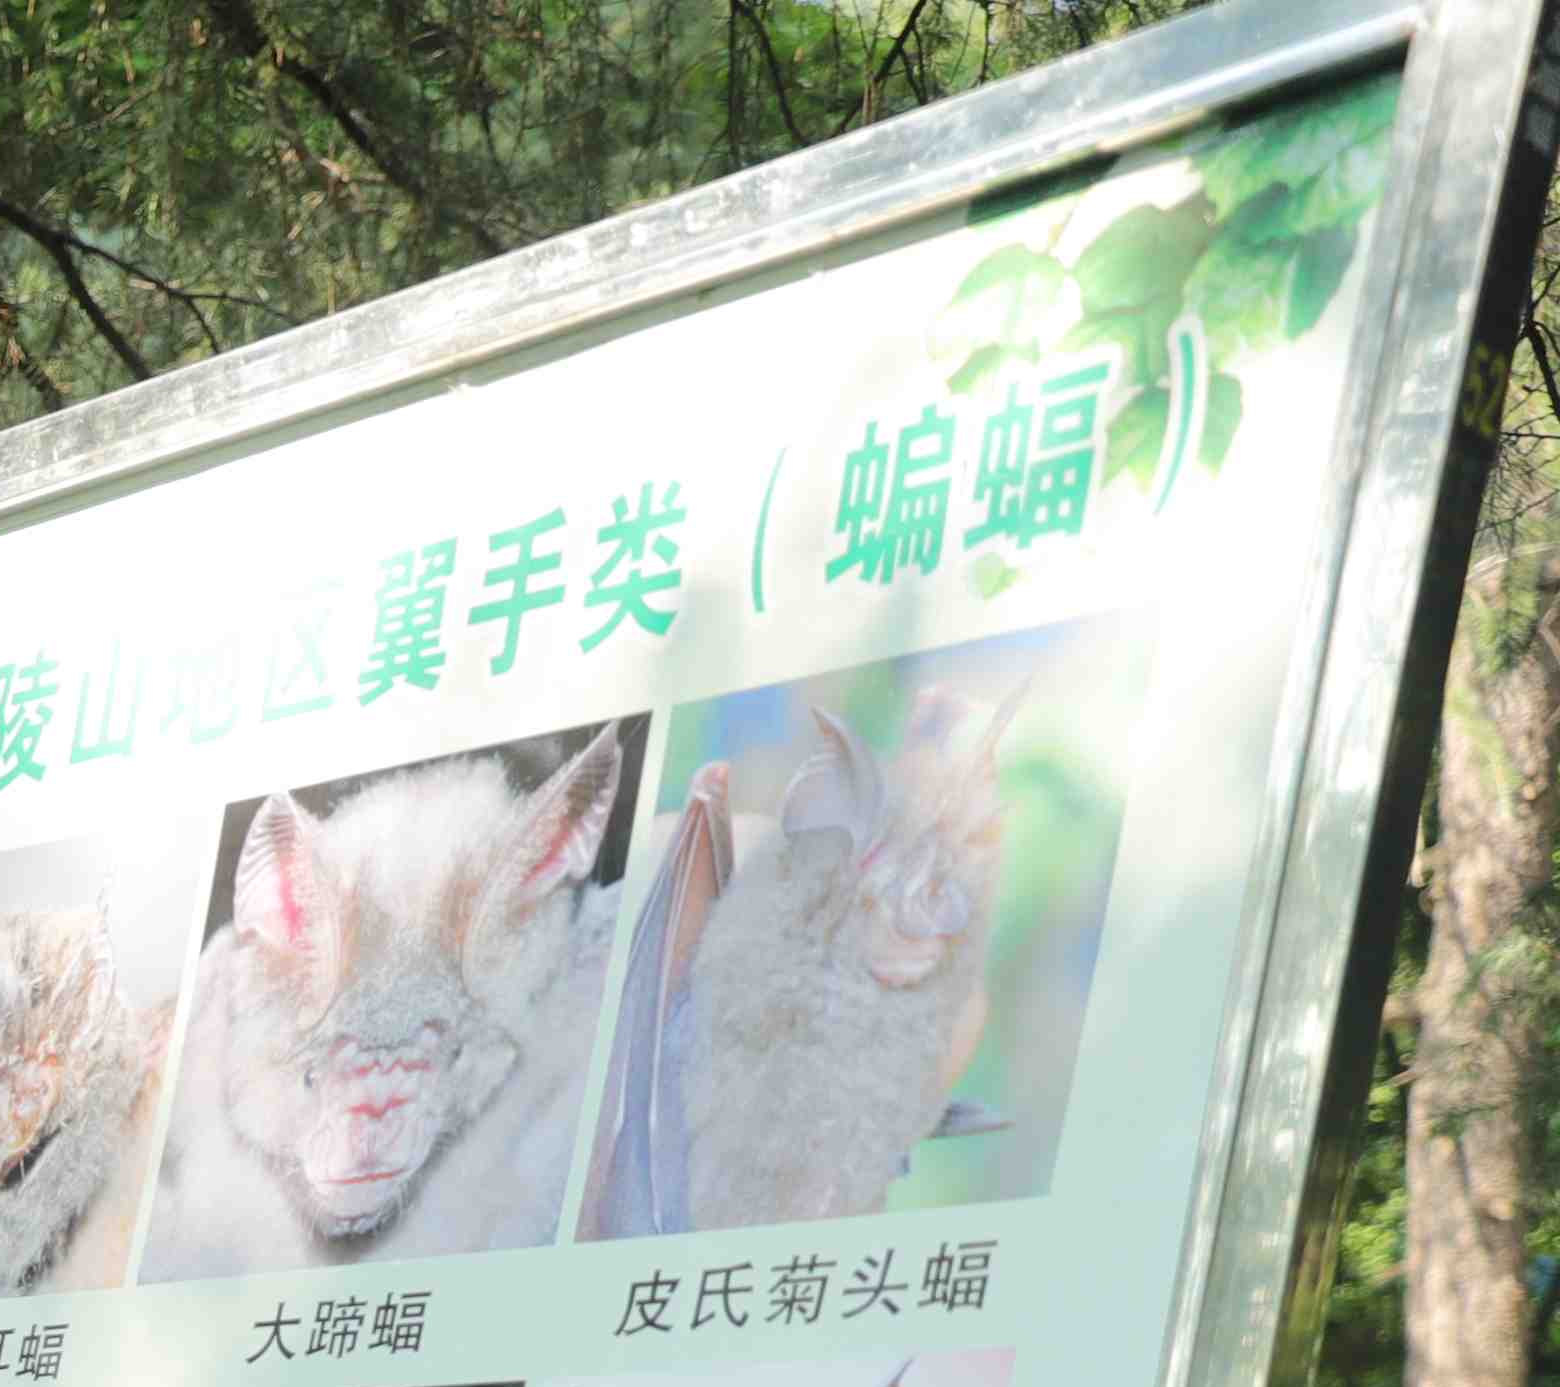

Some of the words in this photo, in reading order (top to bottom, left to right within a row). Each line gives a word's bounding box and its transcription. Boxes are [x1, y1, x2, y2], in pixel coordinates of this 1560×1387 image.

[247, 1289, 433, 1366] 大蹄蝠
[616, 1237, 998, 1339] 皮氏菊头蝠
